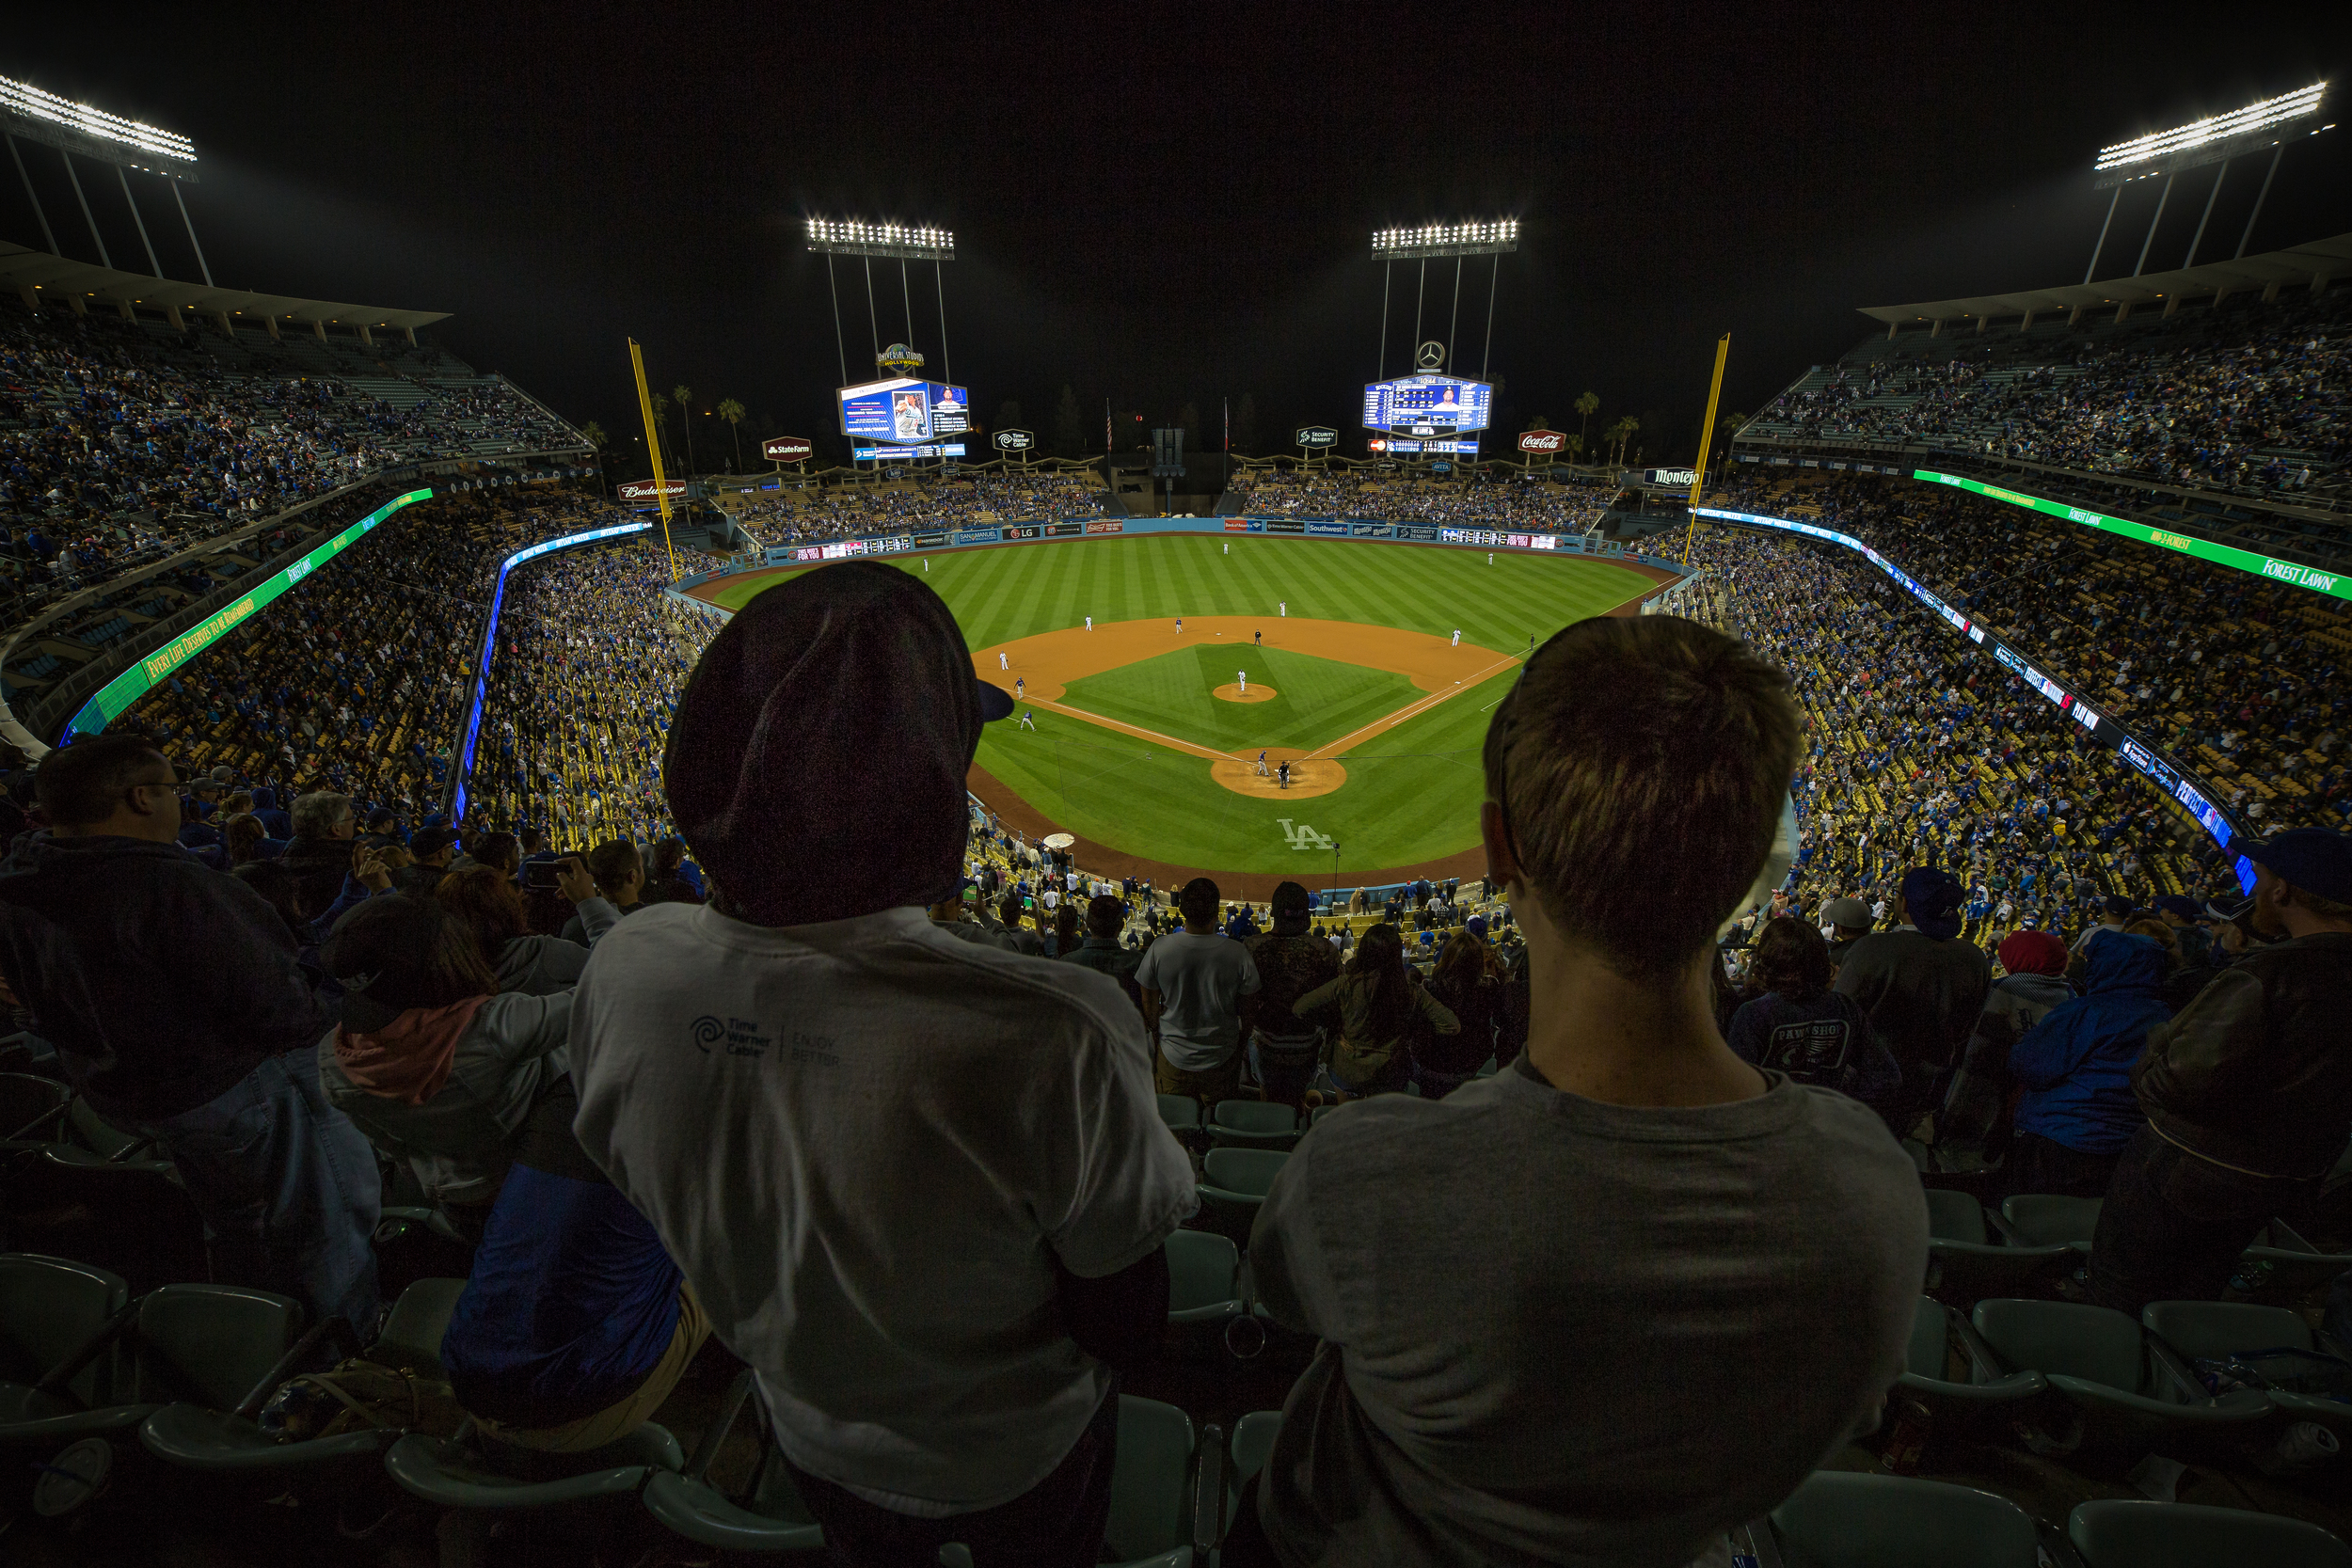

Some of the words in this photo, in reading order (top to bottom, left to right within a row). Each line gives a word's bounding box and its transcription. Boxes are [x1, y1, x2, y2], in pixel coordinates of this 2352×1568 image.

[877, 351, 905, 362] UNIVERSAL
[905, 351, 925, 362] STUDIOS
[1521, 435, 1561, 449] Coca-Cola
[1655, 469, 1699, 485] Montejo
[621, 484, 685, 498] Budweiser
[1723, 512, 1742, 521] WATER
[2068, 508, 2087, 522] FOREST
[620, 523, 641, 532] WATER
[1310, 524, 1343, 533] Southwest
[1773, 519, 1791, 529] WATER
[572, 533, 590, 543] WATER
[1021, 529, 1033, 537] LG
[2150, 531, 2192, 550] 800-2-FOREST
[286, 563, 302, 583] FOREST
[2262, 559, 2302, 581] FOREST
[147, 652, 171, 678] EVERY
[167, 643, 185, 663] LIFE
[182, 626, 213, 655] DESERVES
[209, 621, 219, 636] TO
[216, 616, 227, 630] BE
[222, 597, 255, 626] REMEMBERED
[2174, 780, 2205, 816] PERFECT
[1276, 818, 1334, 850] LA
[728, 1018, 758, 1032] Time
[728, 1031, 771, 1047] Warner
[793, 1032, 835, 1050] ENJOY
[726, 1043, 761, 1058] Cable
[792, 1048, 840, 1067] BETTER
